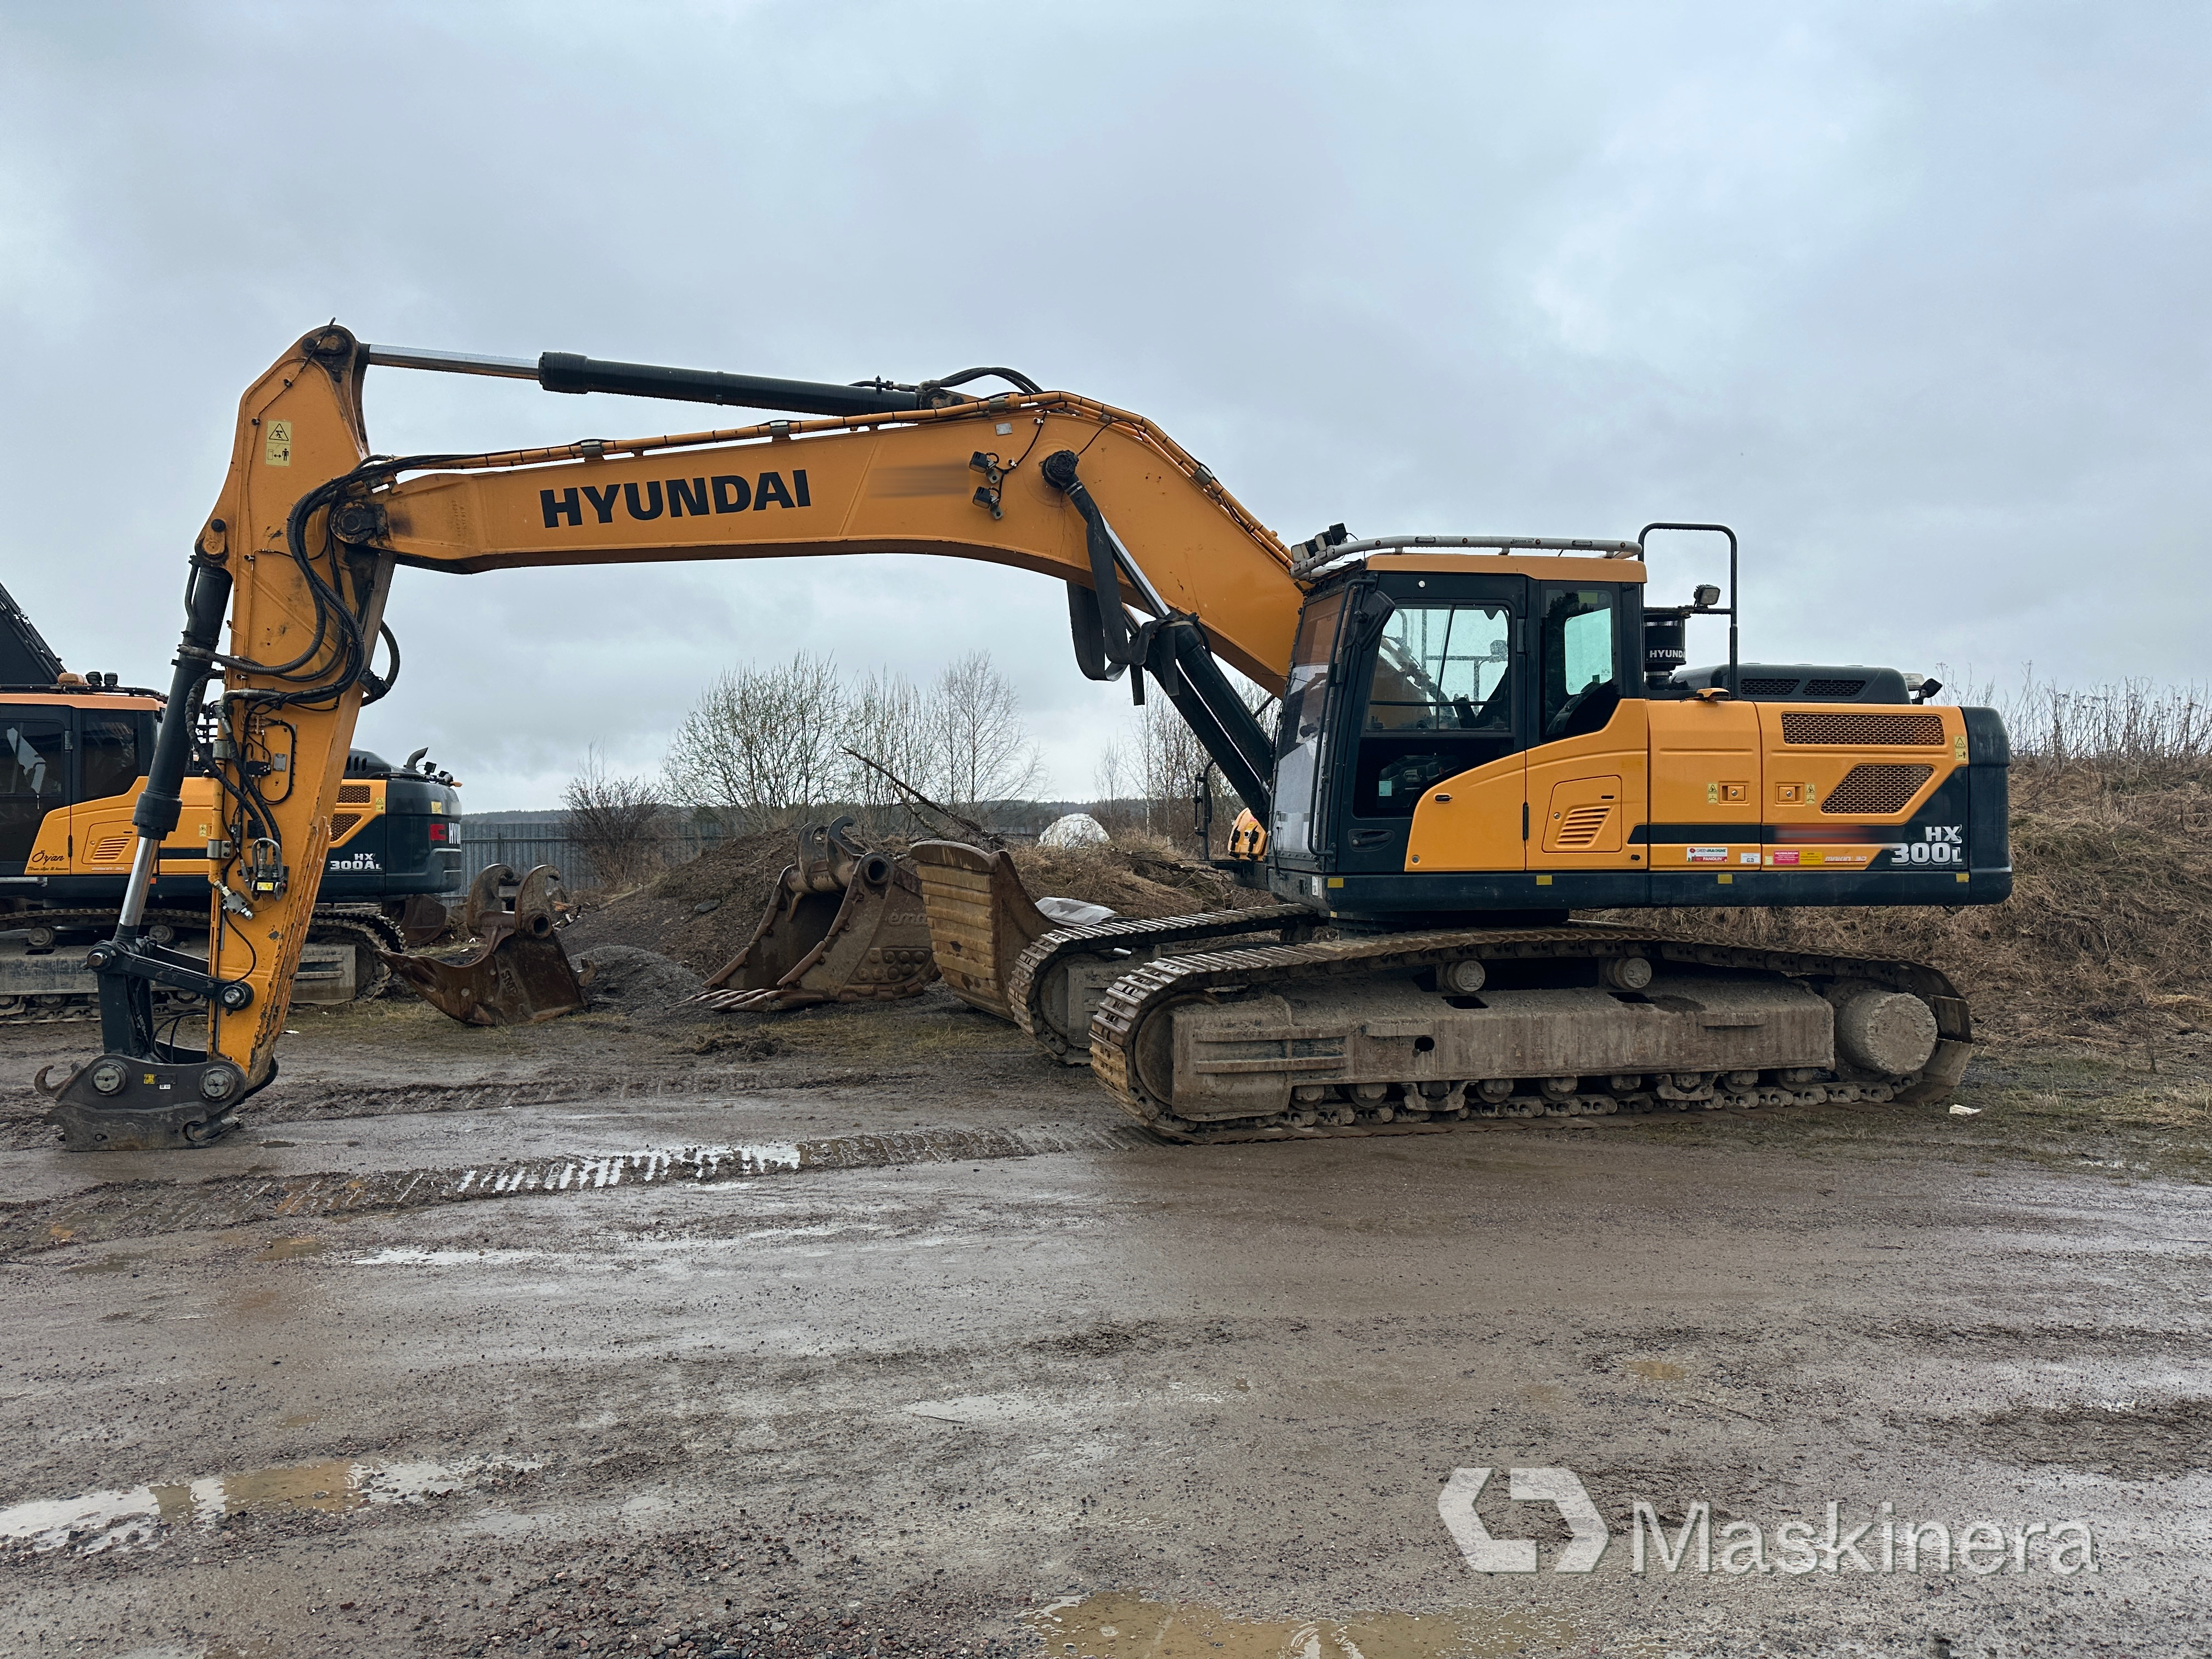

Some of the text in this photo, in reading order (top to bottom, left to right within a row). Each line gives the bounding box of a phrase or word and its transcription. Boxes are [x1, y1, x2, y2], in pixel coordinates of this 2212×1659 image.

[540, 470, 811, 528] HYUNDAI
[1649, 650, 1685, 658] HYUND
[1925, 825, 1962, 843] HX
[32, 850, 64, 865] Örjan
[330, 860, 382, 870] 300AL
